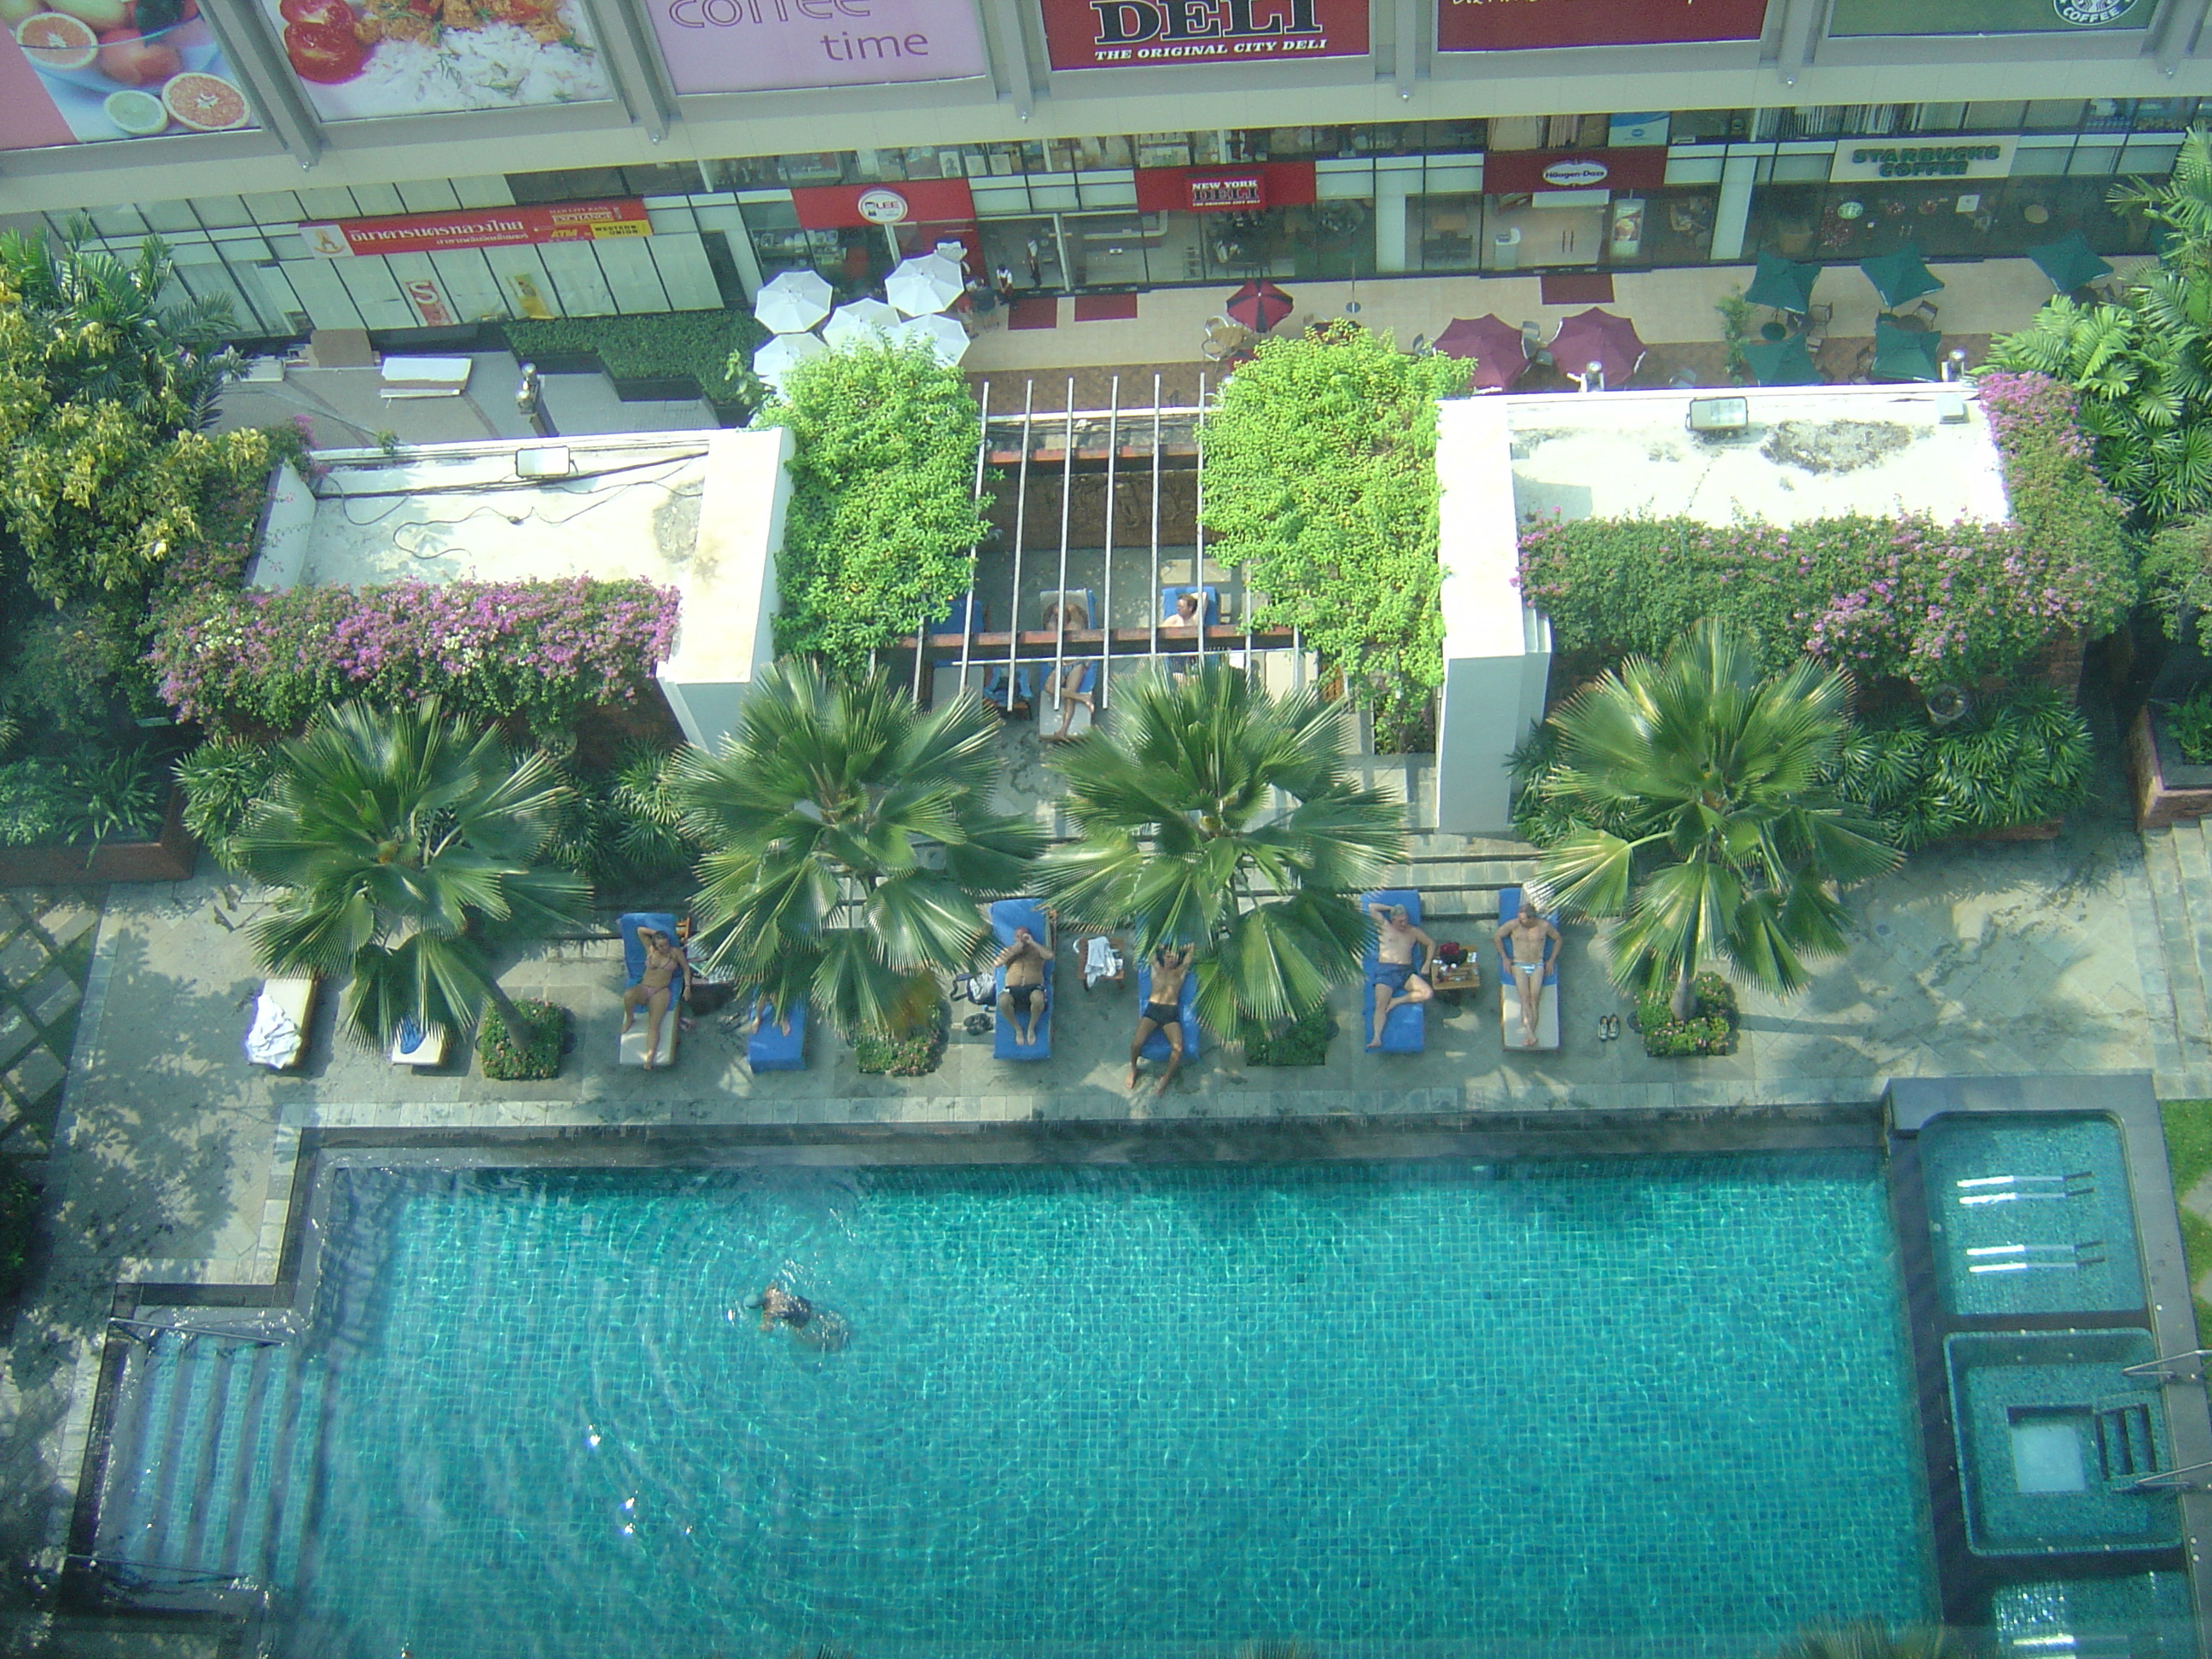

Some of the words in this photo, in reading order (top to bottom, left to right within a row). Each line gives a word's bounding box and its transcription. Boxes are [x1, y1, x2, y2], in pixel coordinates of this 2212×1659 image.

[1090, 0, 1323, 44] DELI
[2063, 7, 2119, 23] COFFEE
[820, 31, 928, 61] time
[1095, 49, 1132, 61] THE
[1138, 44, 1227, 59] ORIGINAL
[1234, 42, 1277, 53] CITY
[1282, 38, 1327, 50] DELI
[1852, 145, 2000, 164] STARBUCKS
[1878, 160, 1969, 178] COFFEE
[1192, 187, 1259, 202] DELI
